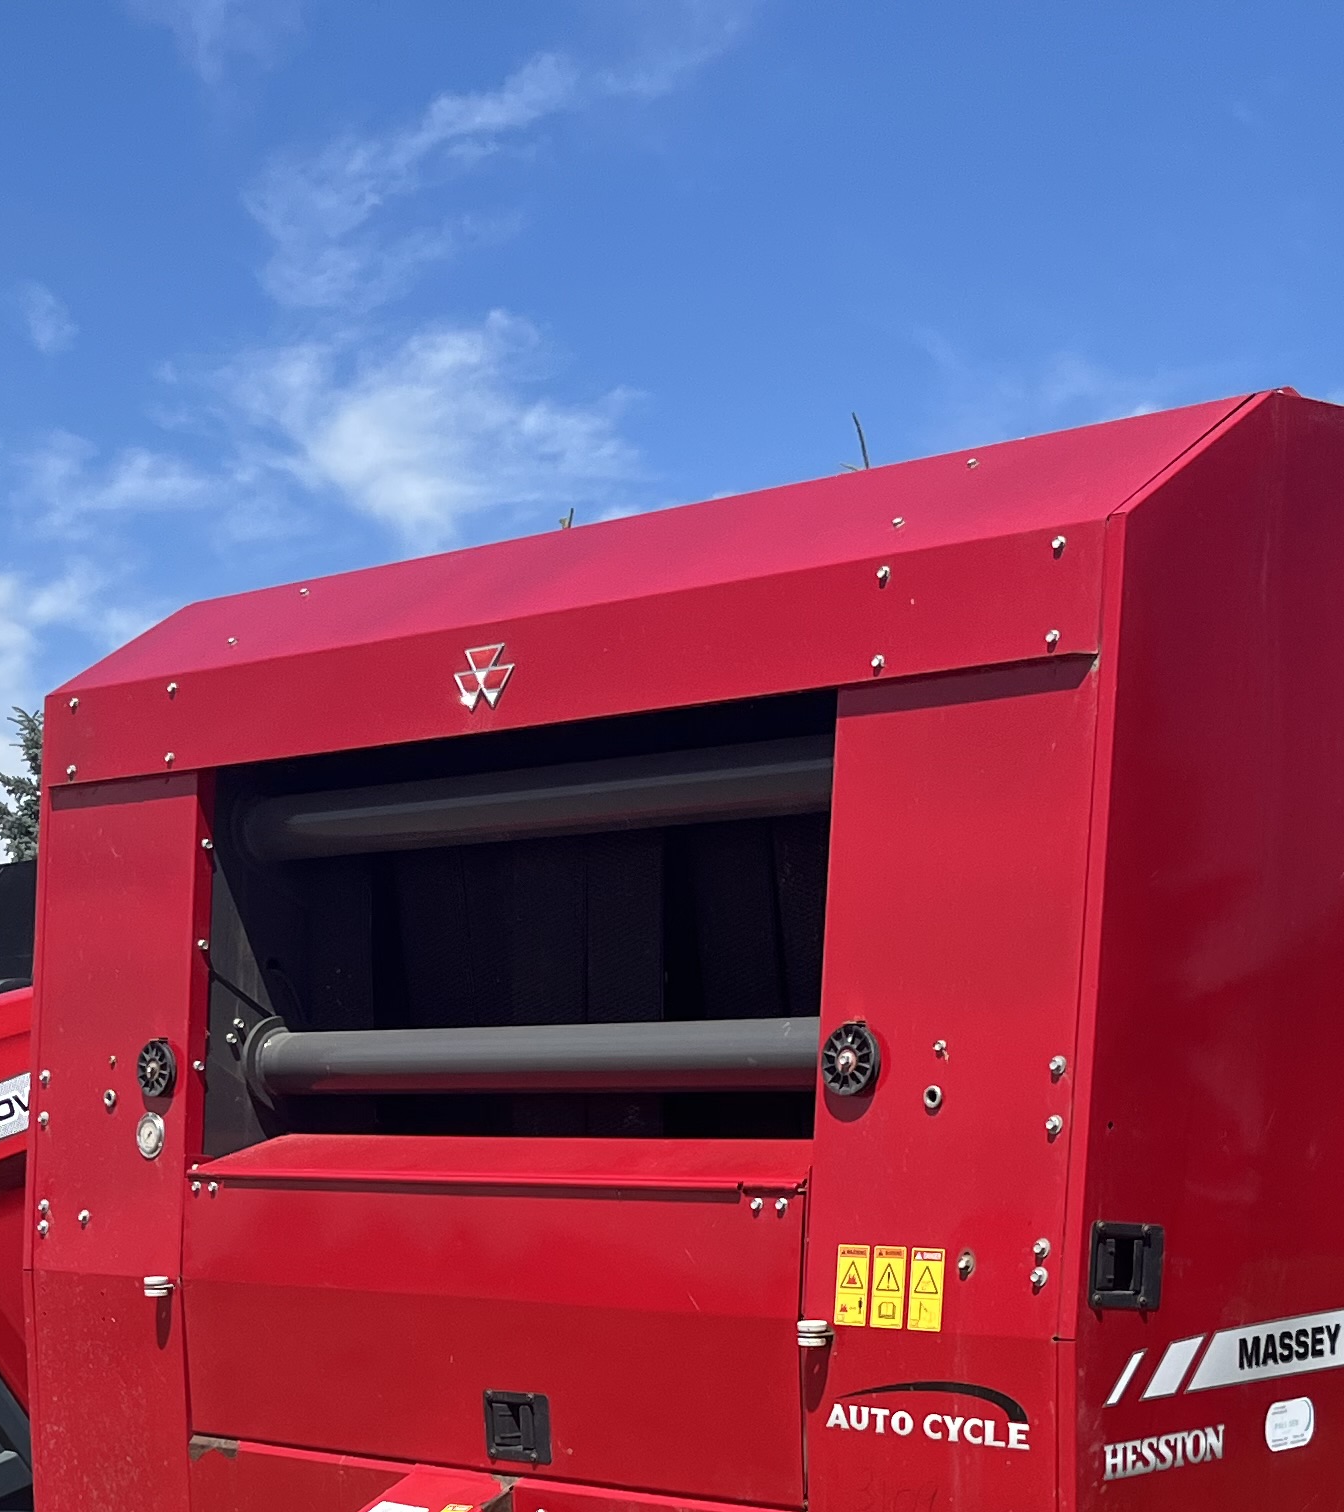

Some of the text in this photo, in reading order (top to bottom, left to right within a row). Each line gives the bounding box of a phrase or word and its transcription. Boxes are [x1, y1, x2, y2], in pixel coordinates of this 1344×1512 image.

[1238, 1323, 1342, 1371] MASSEY
[825, 1402, 1031, 1451] AUTO CYCLE
[1102, 1423, 1225, 1482] HESSTON
